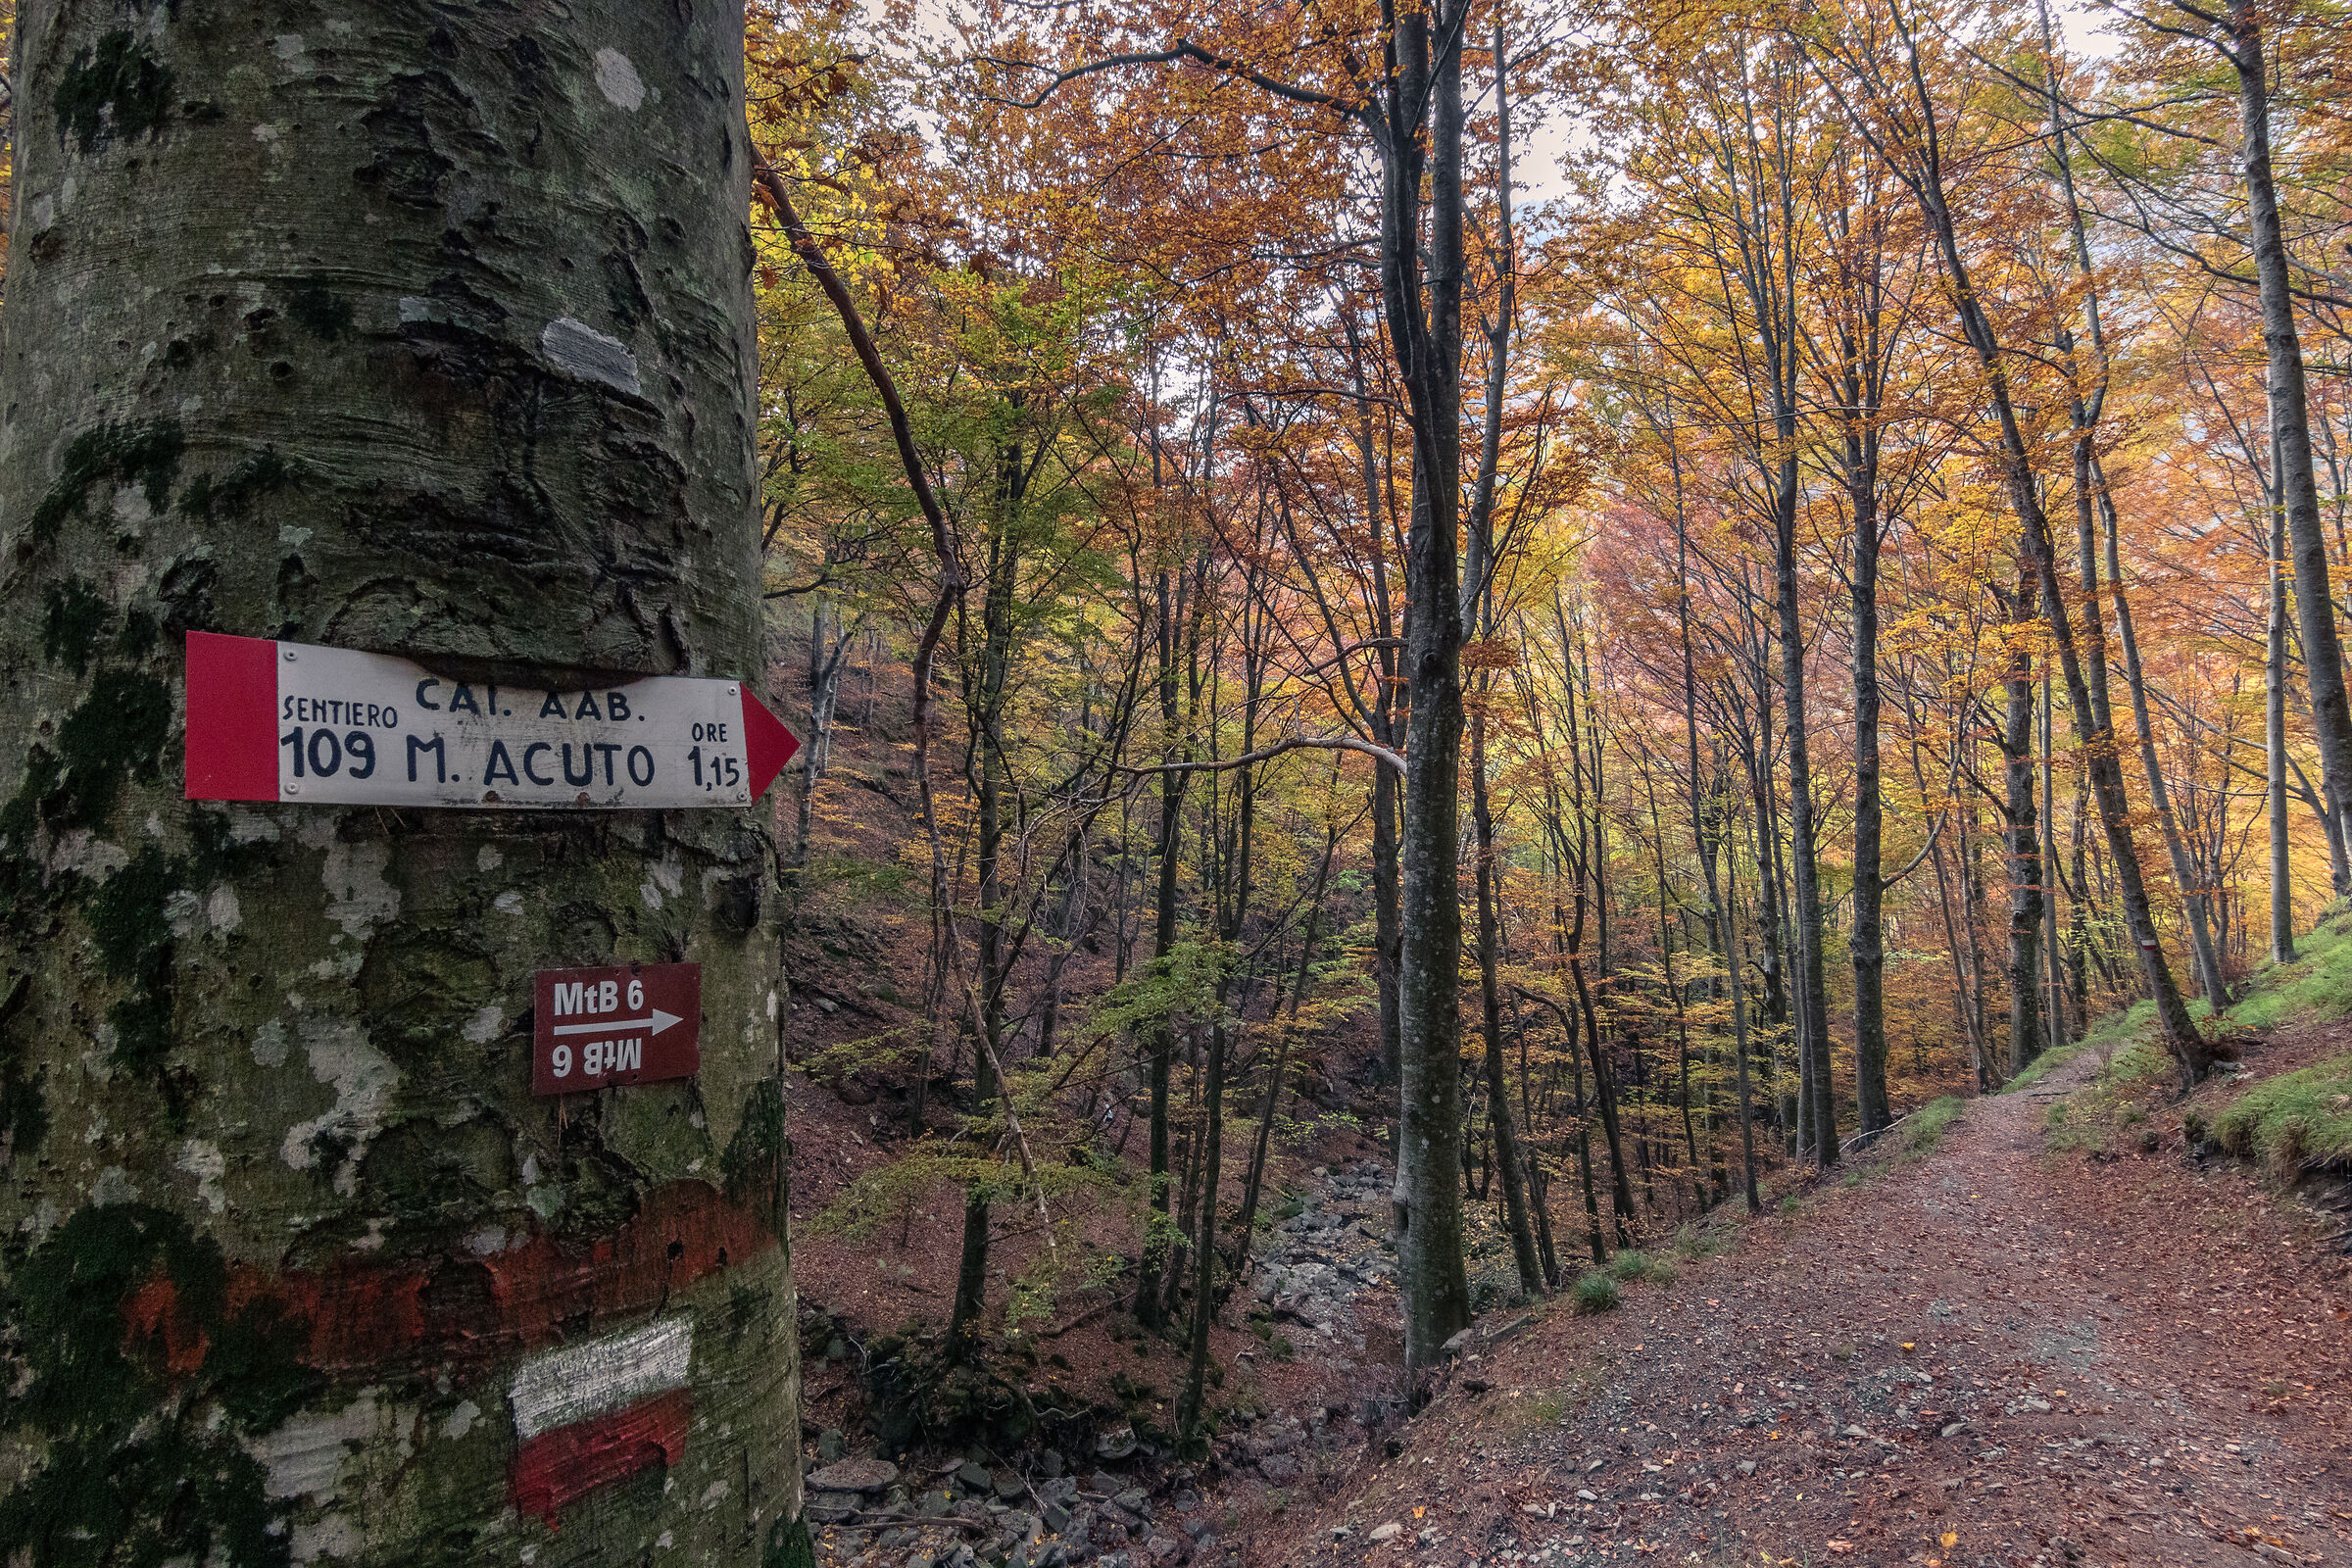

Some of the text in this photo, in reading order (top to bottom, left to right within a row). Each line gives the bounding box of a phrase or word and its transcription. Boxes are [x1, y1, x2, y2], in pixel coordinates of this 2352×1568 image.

[282, 695, 398, 728] SENTIERO
[416, 678, 645, 721] CAI. AAB.
[691, 722, 727, 742] ORE
[280, 726, 656, 786] 109 M. ACUTO
[687, 746, 740, 791] 1,15
[554, 980, 644, 1016] MtB 6
